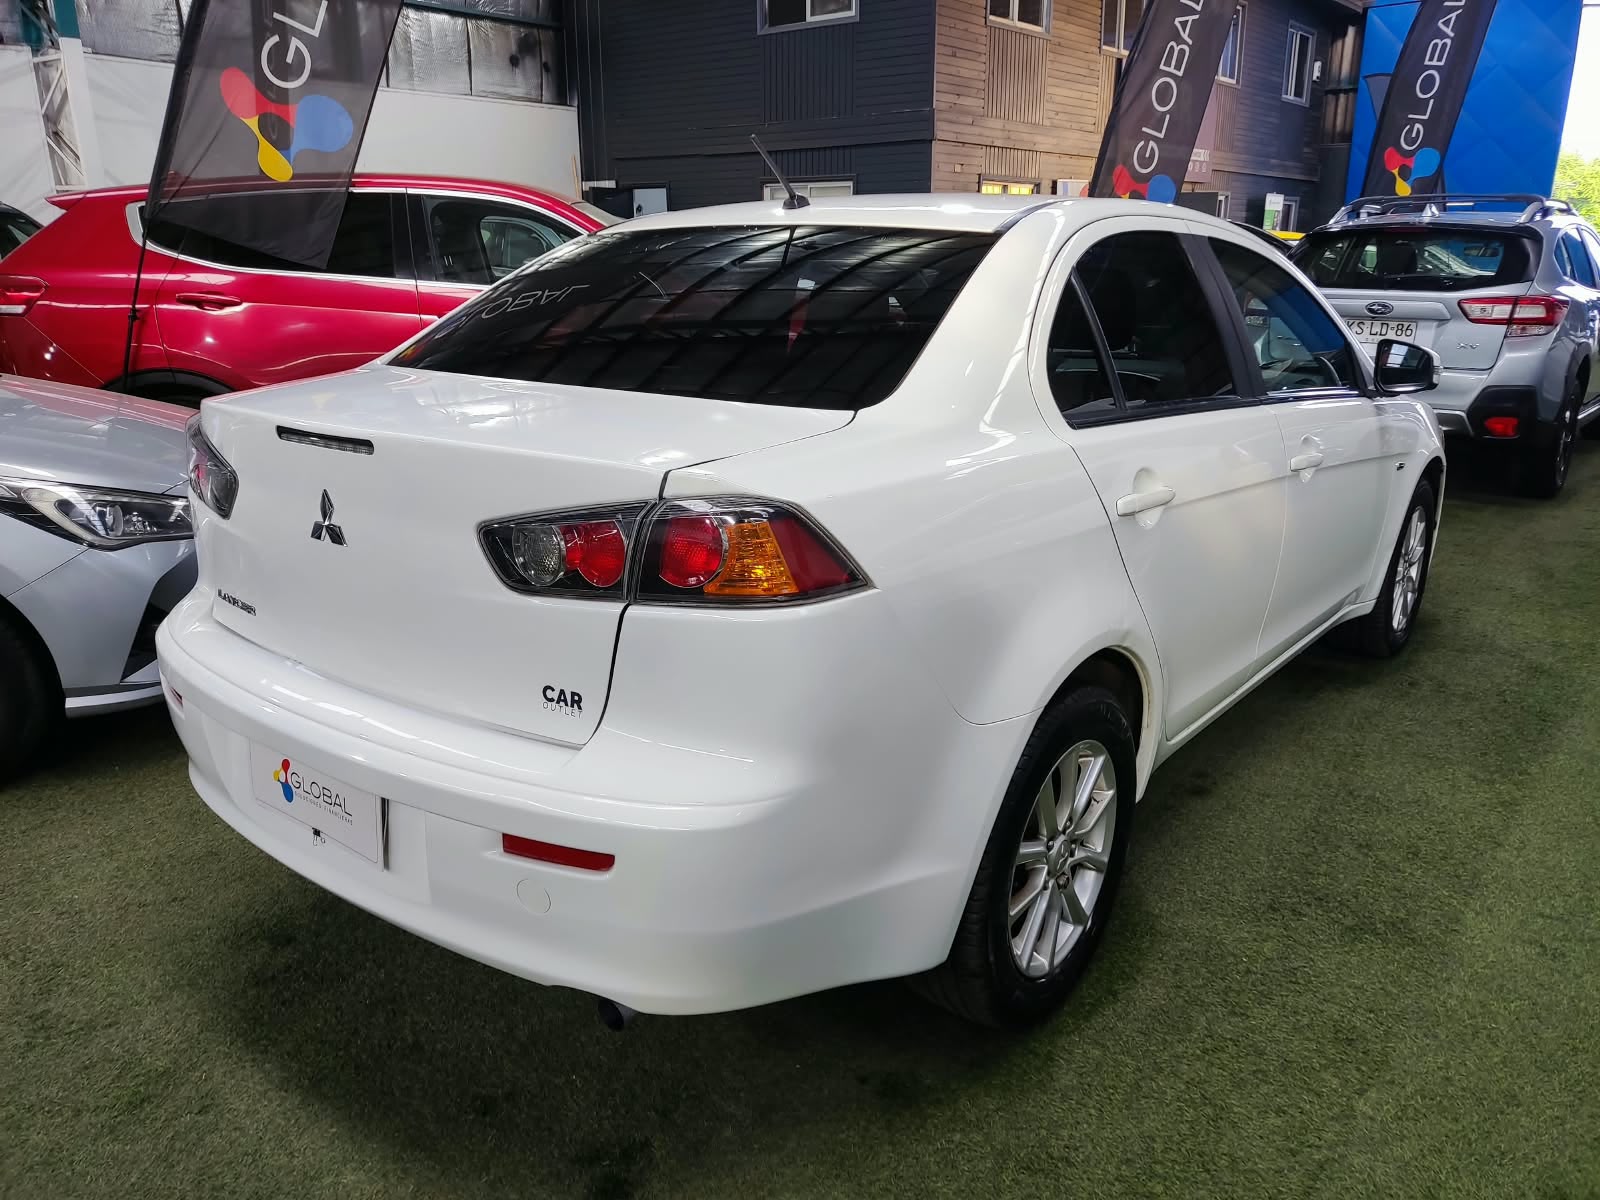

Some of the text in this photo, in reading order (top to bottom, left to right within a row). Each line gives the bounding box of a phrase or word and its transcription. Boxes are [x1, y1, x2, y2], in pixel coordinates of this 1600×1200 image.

[1133, 0, 1203, 173] GLOBAL
[1400, 0, 1466, 150] GLOBAL
[542, 685, 583, 710] CAR
[543, 701, 583, 719] OUTLET
[290, 771, 353, 817] GLOBAL
